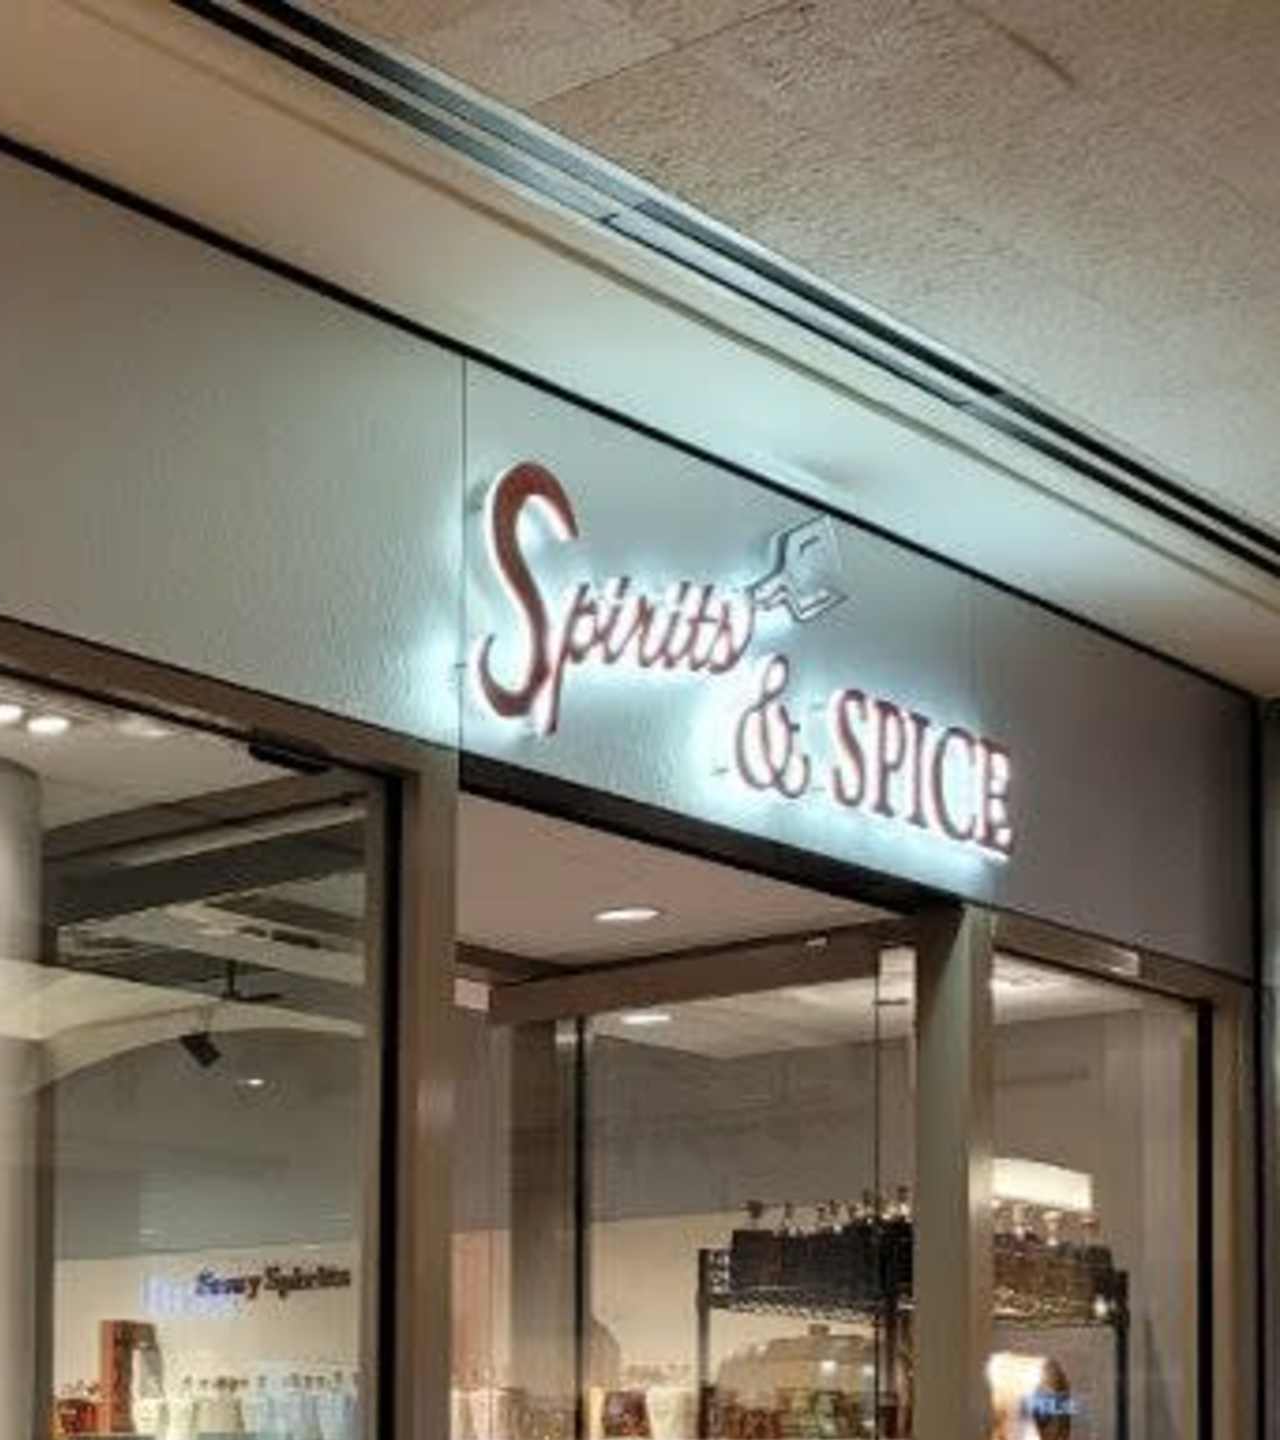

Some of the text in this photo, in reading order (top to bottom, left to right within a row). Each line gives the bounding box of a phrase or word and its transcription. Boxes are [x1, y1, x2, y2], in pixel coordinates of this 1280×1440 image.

[478, 461, 756, 735] Spirits
[736, 654, 1013, 854] & SPICE
[263, 1266, 351, 1299] Spirits
